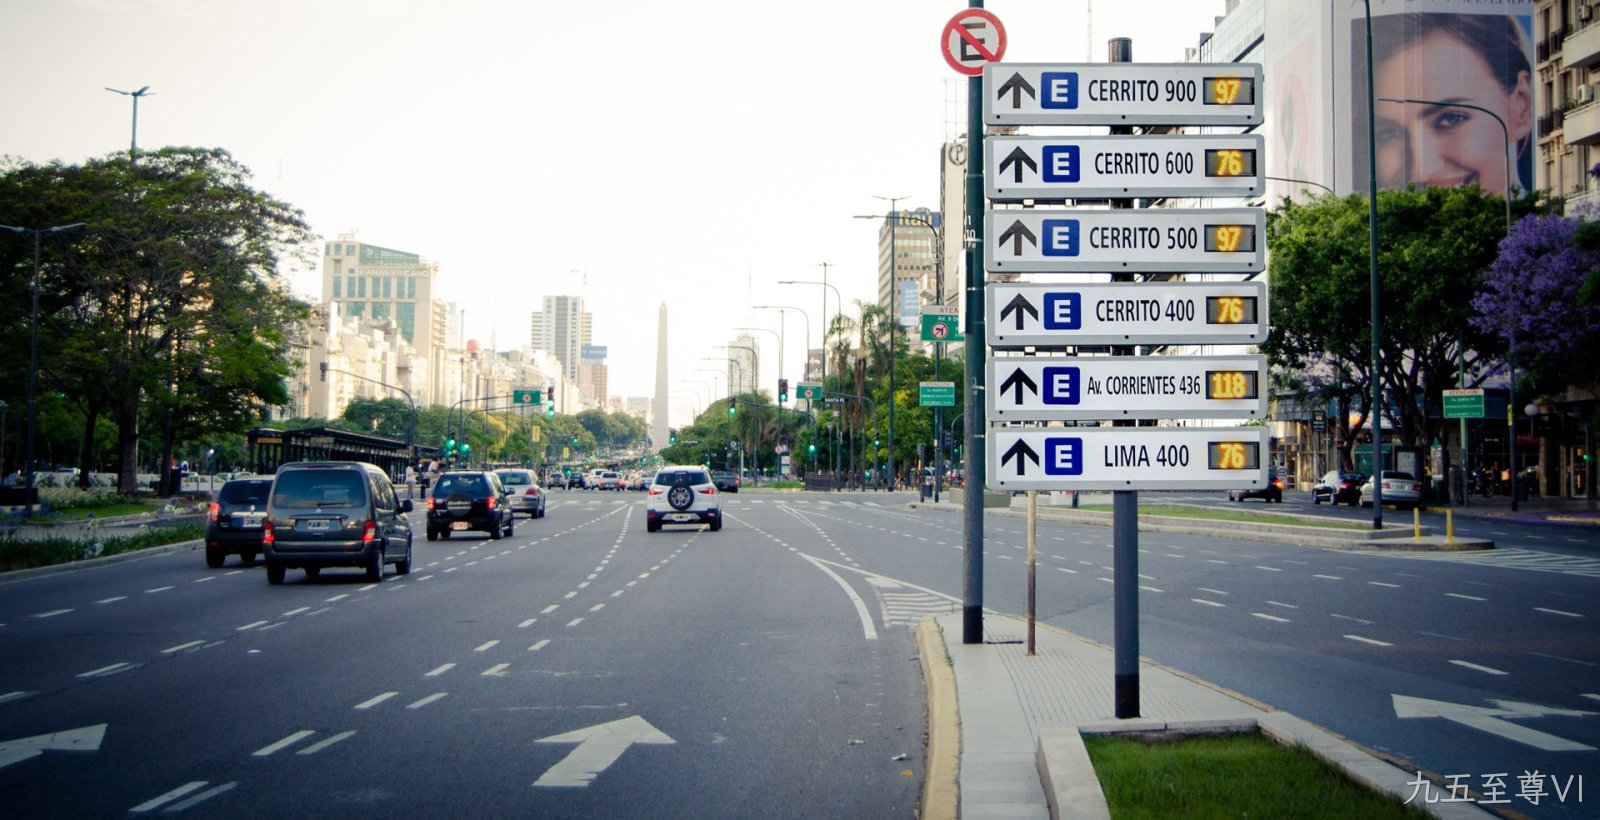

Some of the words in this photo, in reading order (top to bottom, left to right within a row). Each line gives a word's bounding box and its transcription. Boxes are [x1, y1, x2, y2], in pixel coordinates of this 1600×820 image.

[1051, 79, 1068, 102] E
[1088, 79, 1159, 102] CERRITO
[1165, 79, 1197, 102] 900
[1215, 80, 1240, 104] 97
[1052, 153, 1069, 175] E
[1094, 152, 1159, 175] CERRITO
[1166, 152, 1193, 174] 600
[1217, 150, 1241, 175] 76
[1052, 226, 1069, 249] E
[1089, 226, 1160, 249] CERRITO
[1167, 227, 1198, 249] 500
[1216, 227, 1241, 252] 97
[1054, 300, 1071, 323] E
[1096, 299, 1160, 322] CERRITO
[1164, 299, 1195, 322] 400
[1218, 298, 1243, 323] 76
[1053, 374, 1070, 397] E
[1087, 376, 1102, 395] Av.
[1106, 375, 1176, 395] CORRIENTES
[1179, 375, 1200, 395] 436
[1212, 373, 1246, 398] 118
[1055, 445, 1072, 468] E
[1104, 445, 1150, 467] LIMA
[1157, 445, 1189, 467] 400
[1220, 443, 1244, 468] 76
